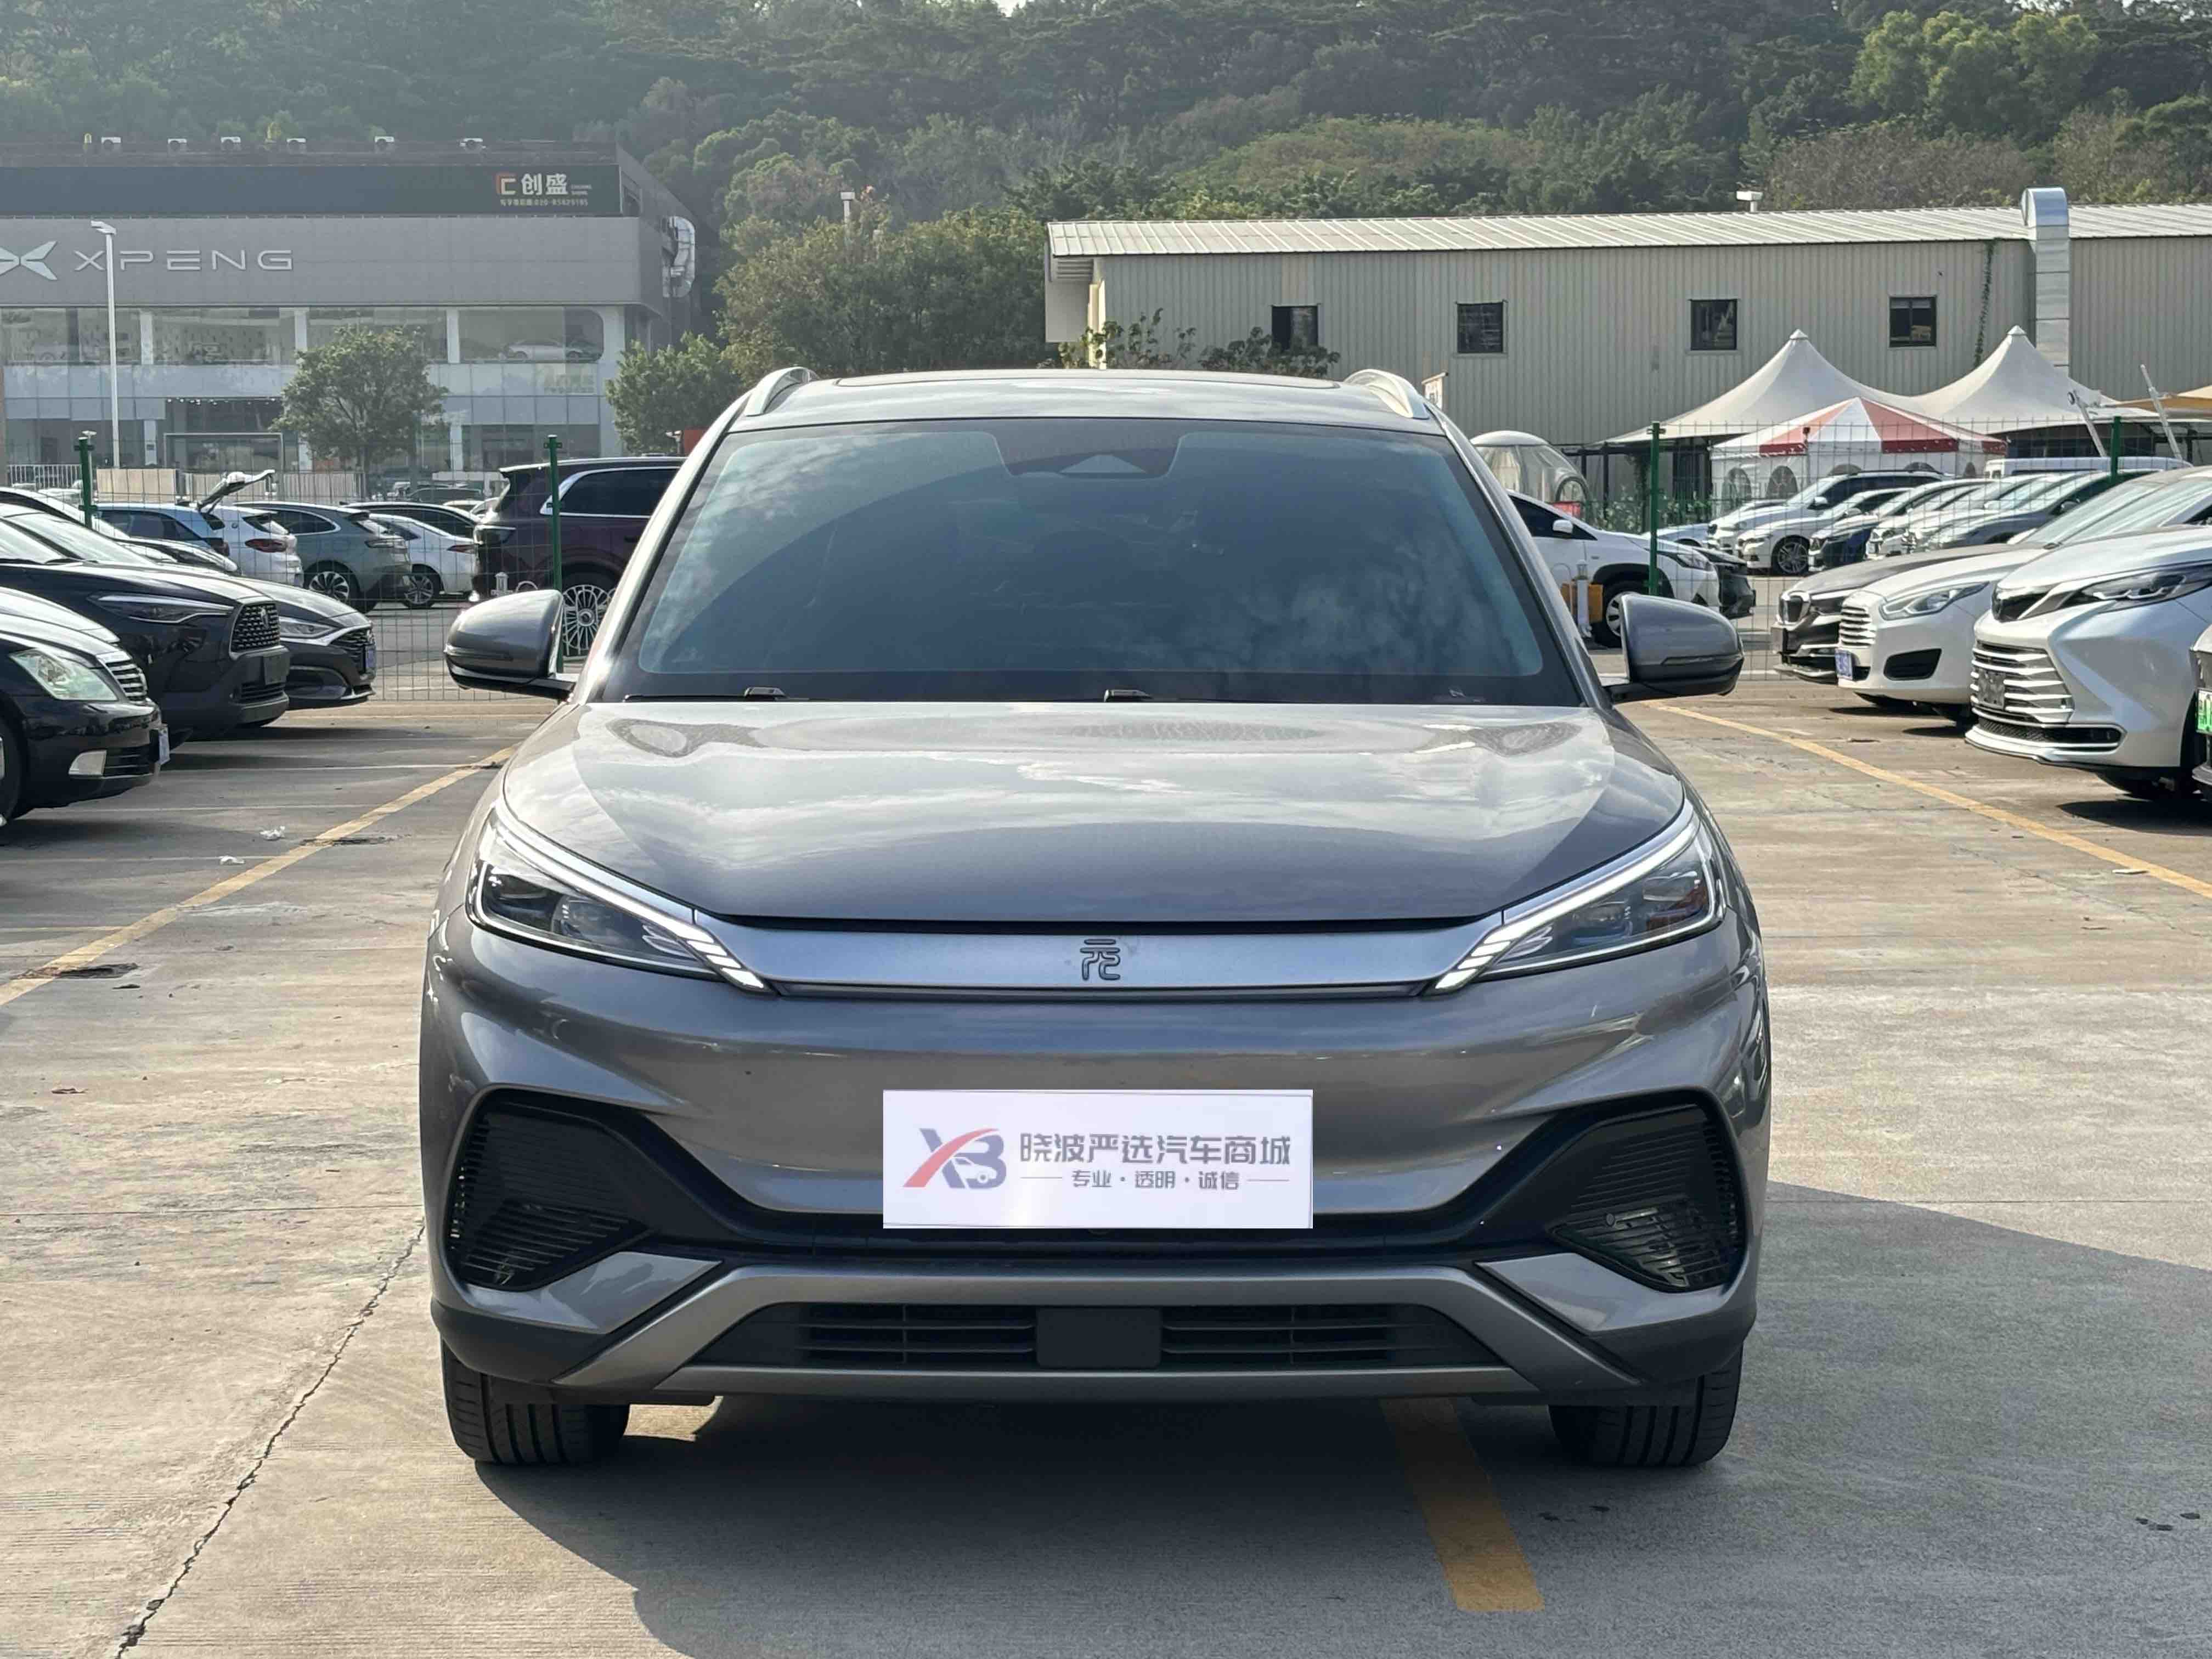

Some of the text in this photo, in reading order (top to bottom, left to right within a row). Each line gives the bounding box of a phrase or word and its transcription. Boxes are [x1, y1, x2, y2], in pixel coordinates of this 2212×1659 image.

[521, 173, 568, 195] 创盛
[74, 250, 292, 271] XPENG
[1080, 939, 1121, 981] 元
